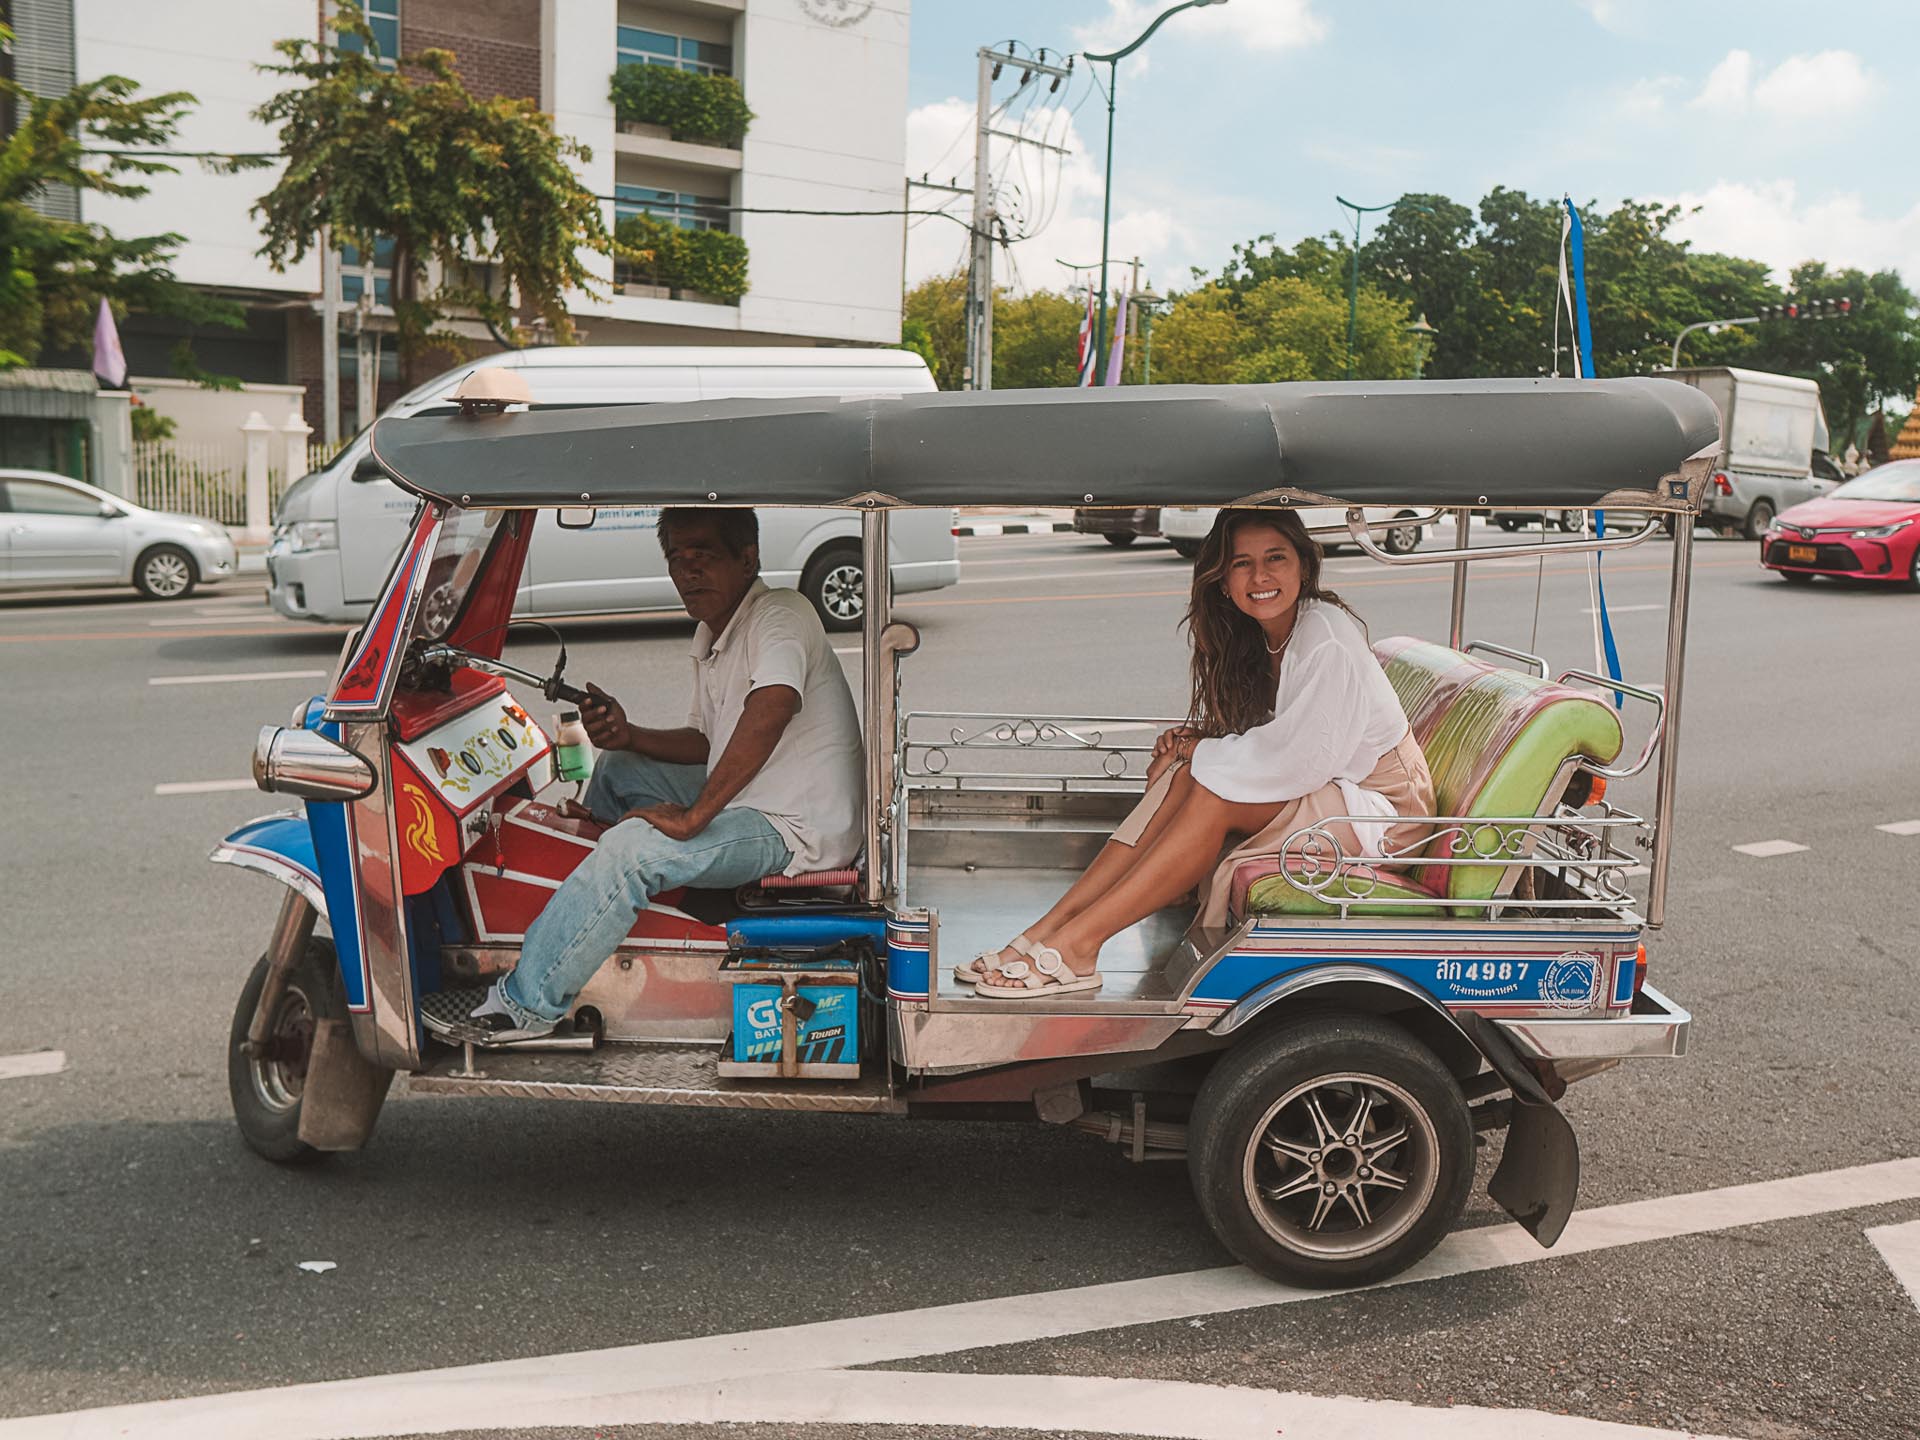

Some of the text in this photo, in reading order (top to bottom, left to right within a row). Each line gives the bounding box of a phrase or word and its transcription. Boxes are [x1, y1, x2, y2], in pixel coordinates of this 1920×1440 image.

[1465, 962, 1529, 980] 4987
[1449, 982, 1518, 997] กรุงเทพมหานคร
[816, 994, 845, 1009] MF
[754, 1021, 805, 1040] BATTY
[810, 1027, 842, 1040] TOUGH
